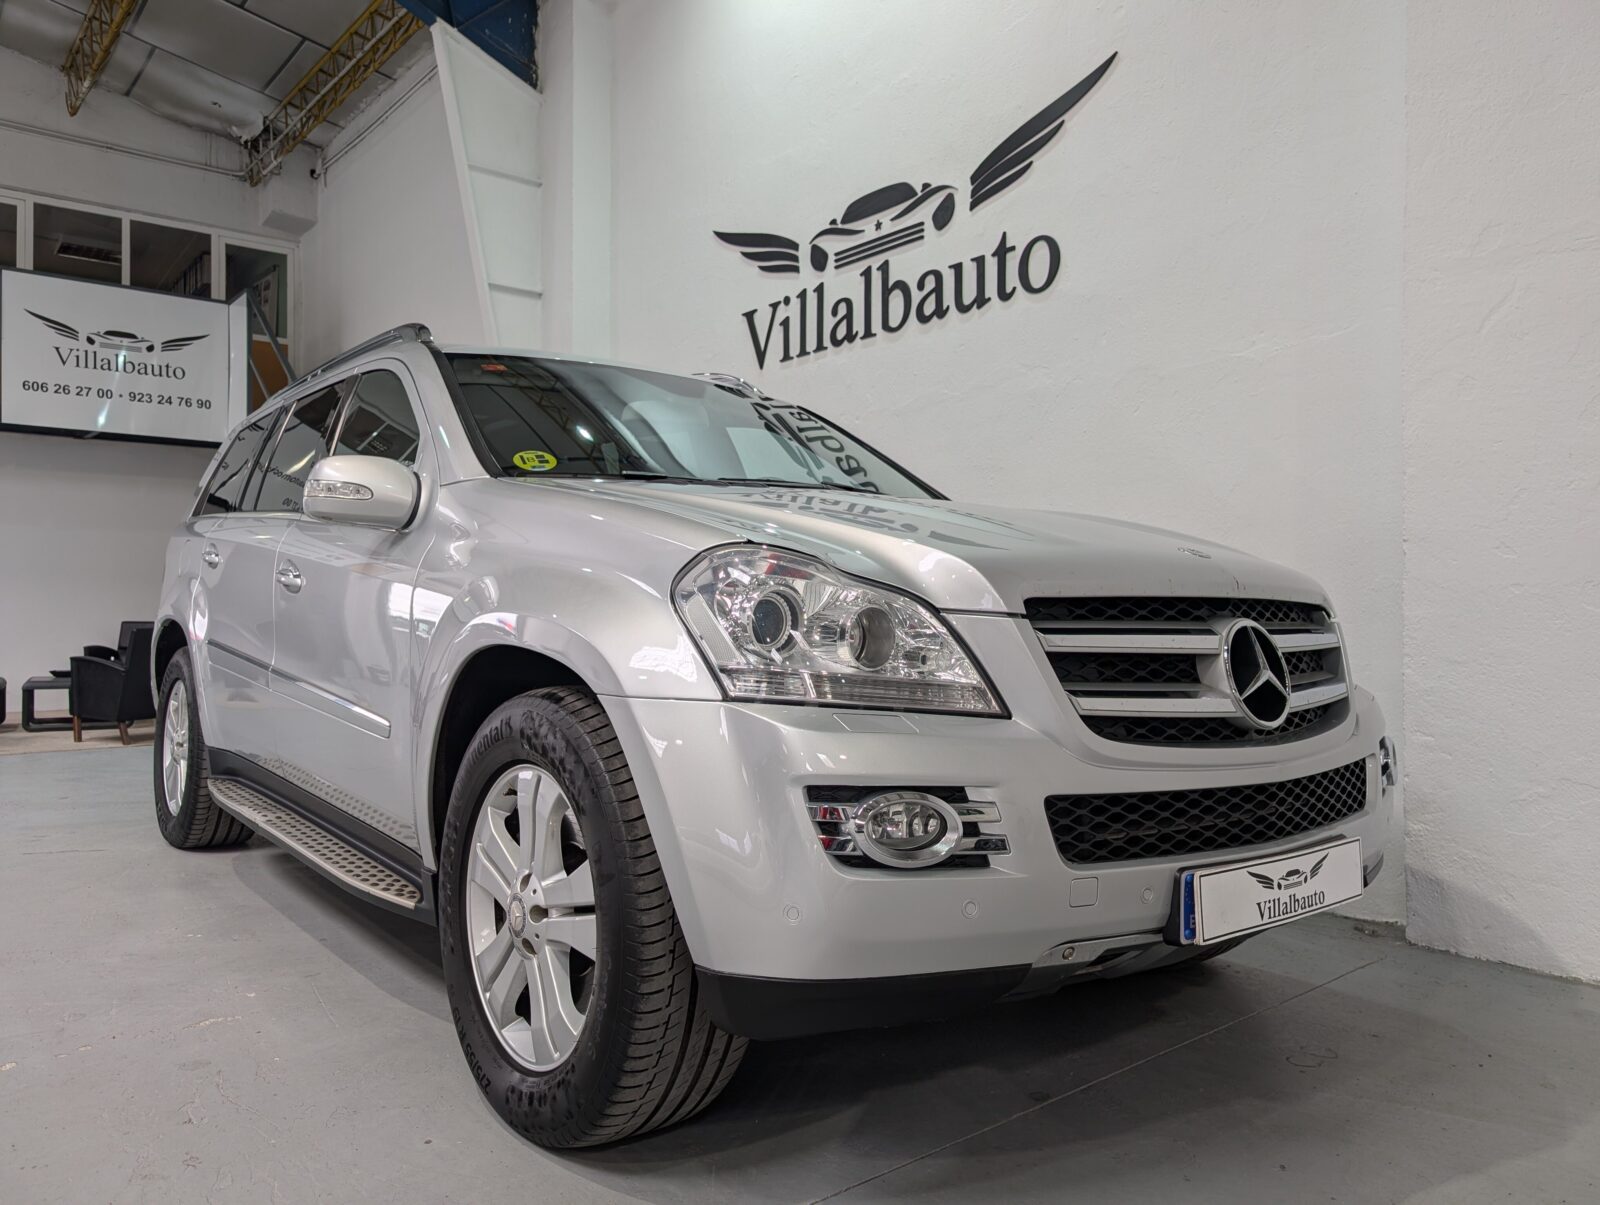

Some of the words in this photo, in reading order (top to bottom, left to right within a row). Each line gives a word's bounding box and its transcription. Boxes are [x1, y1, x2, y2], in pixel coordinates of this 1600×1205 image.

[742, 231, 1061, 370] Villalbauto
[53, 345, 186, 380] Villalbauto
[22, 380, 49, 393] 606
[53, 383, 71, 395] 26
[75, 385, 92, 397] 27
[97, 388, 113, 400] 00
[128, 391, 153, 404] 923
[157, 394, 173, 406] 24
[177, 396, 193, 408] 76
[196, 398, 212, 410] 90
[1256, 890, 1325, 921] Villalbauto
